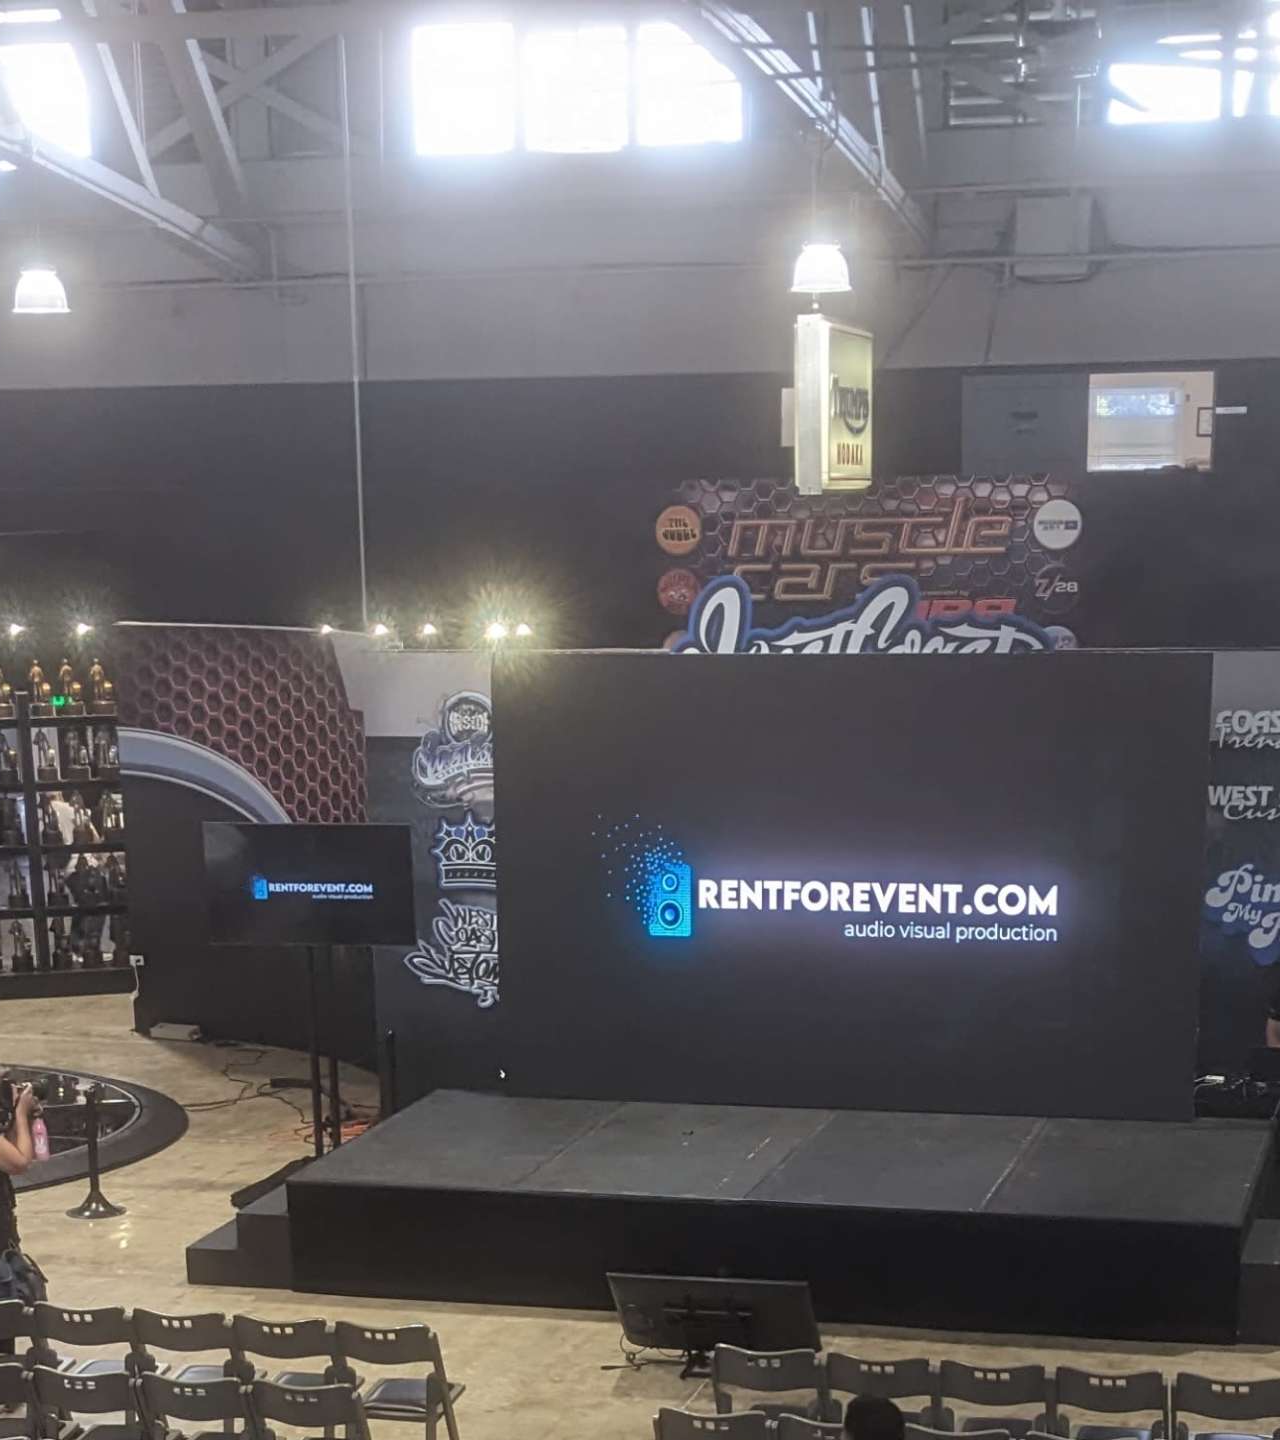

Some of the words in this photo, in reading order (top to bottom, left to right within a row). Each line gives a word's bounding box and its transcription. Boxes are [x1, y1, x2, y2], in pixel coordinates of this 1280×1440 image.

[1208, 785, 1273, 807] WEST
[269, 882, 373, 894] RENTFOREVENT.COM
[698, 878, 1058, 917] RENTFOREVENT.COM
[1222, 901, 1263, 925] My
[844, 921, 896, 939] audio
[899, 921, 951, 940] visual
[955, 922, 1058, 943] production
